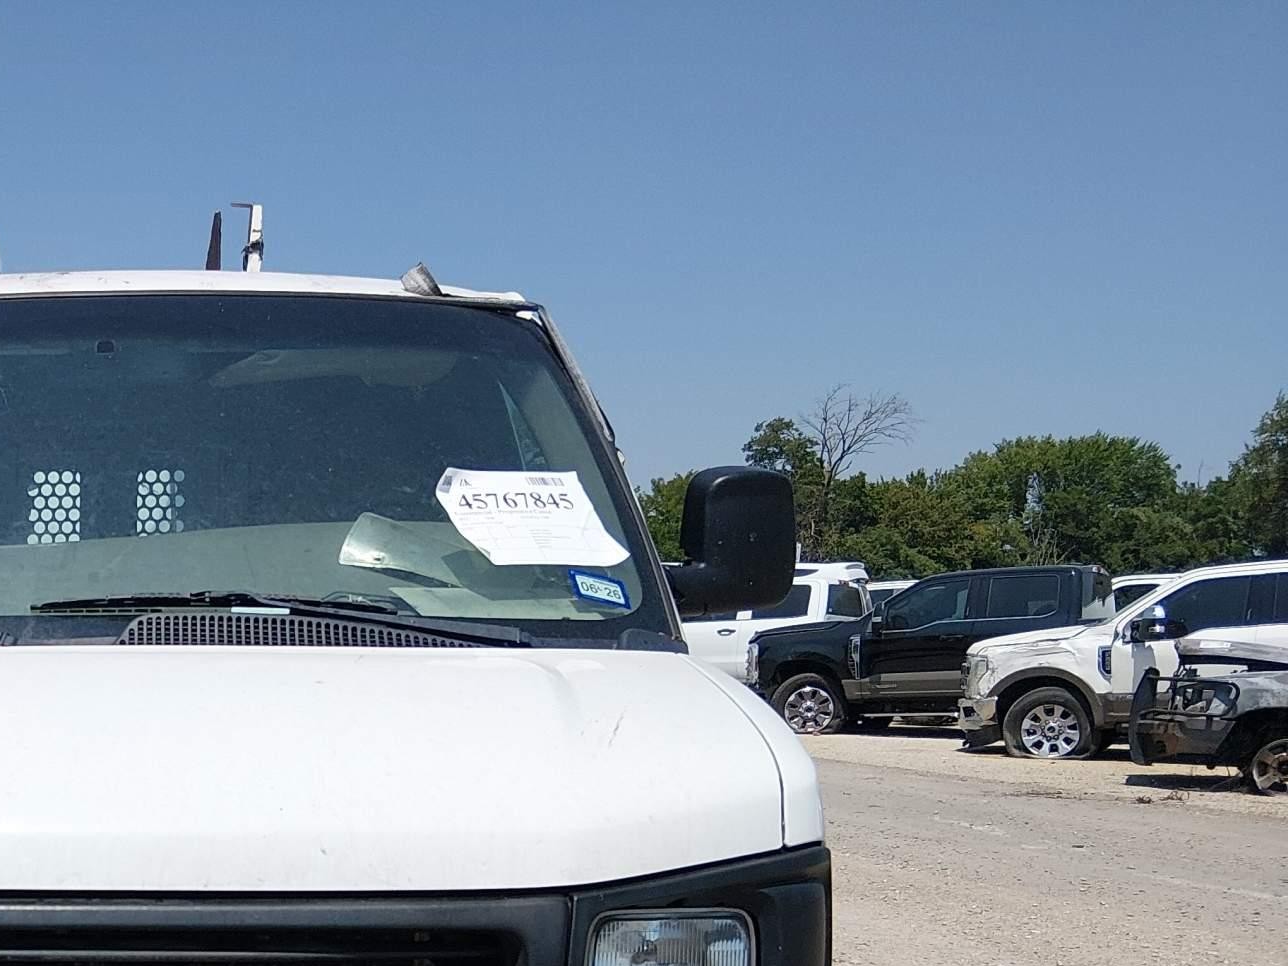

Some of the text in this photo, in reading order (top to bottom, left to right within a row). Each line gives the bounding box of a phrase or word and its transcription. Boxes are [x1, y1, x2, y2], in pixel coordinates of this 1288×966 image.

[459, 492, 574, 510] 45767845
[581, 581, 621, 600] 06 26
